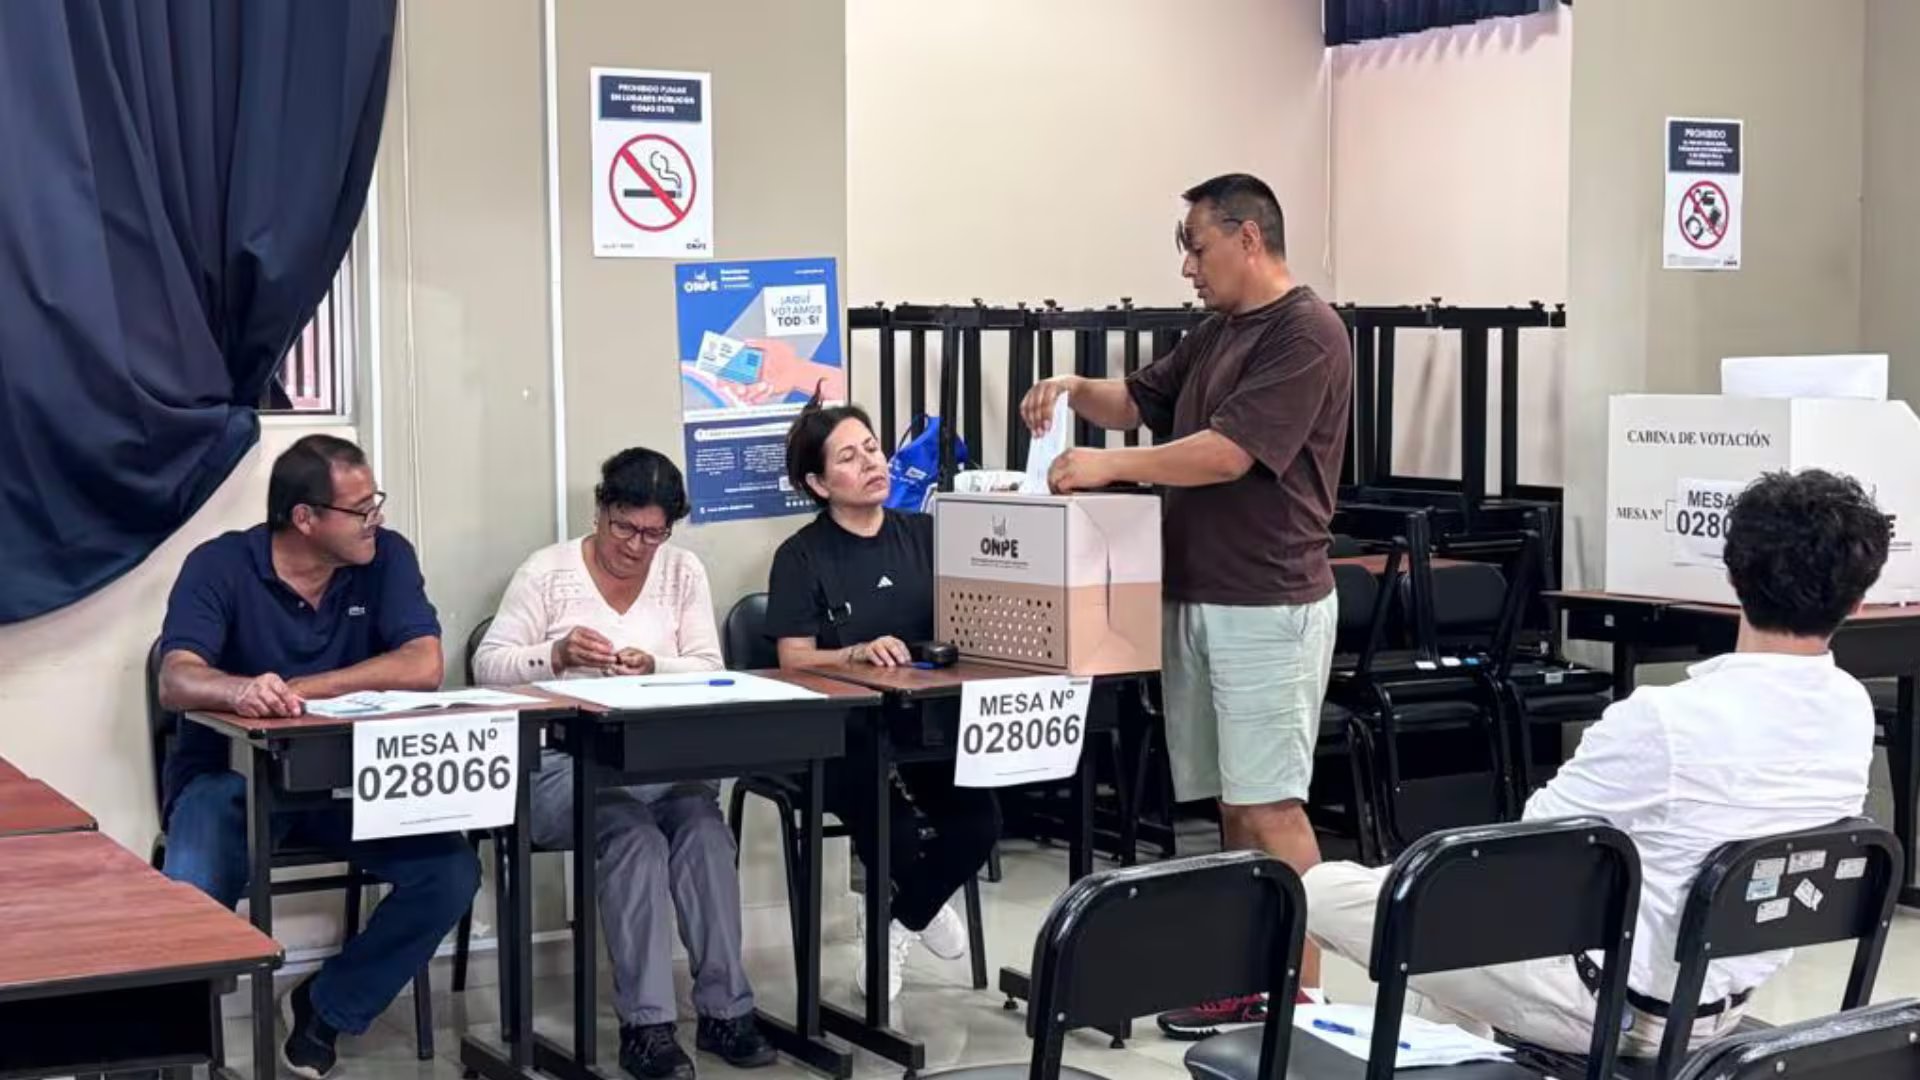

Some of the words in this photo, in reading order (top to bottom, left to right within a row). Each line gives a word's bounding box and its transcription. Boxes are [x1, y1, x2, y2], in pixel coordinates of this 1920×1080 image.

[771, 305, 822, 316] VOTAMOS
[1627, 430, 1676, 445] CABINA
[1678, 431, 1697, 445] DE
[1699, 430, 1772, 447] VOTACIÓN
[1687, 490, 1736, 509] MESA
[1616, 506, 1648, 520] MESA
[980, 537, 1019, 558] ONPE
[980, 692, 1044, 716] MESA
[963, 714, 1081, 755] 028066
[376, 731, 459, 760] MESA
[357, 755, 511, 802] 028066
